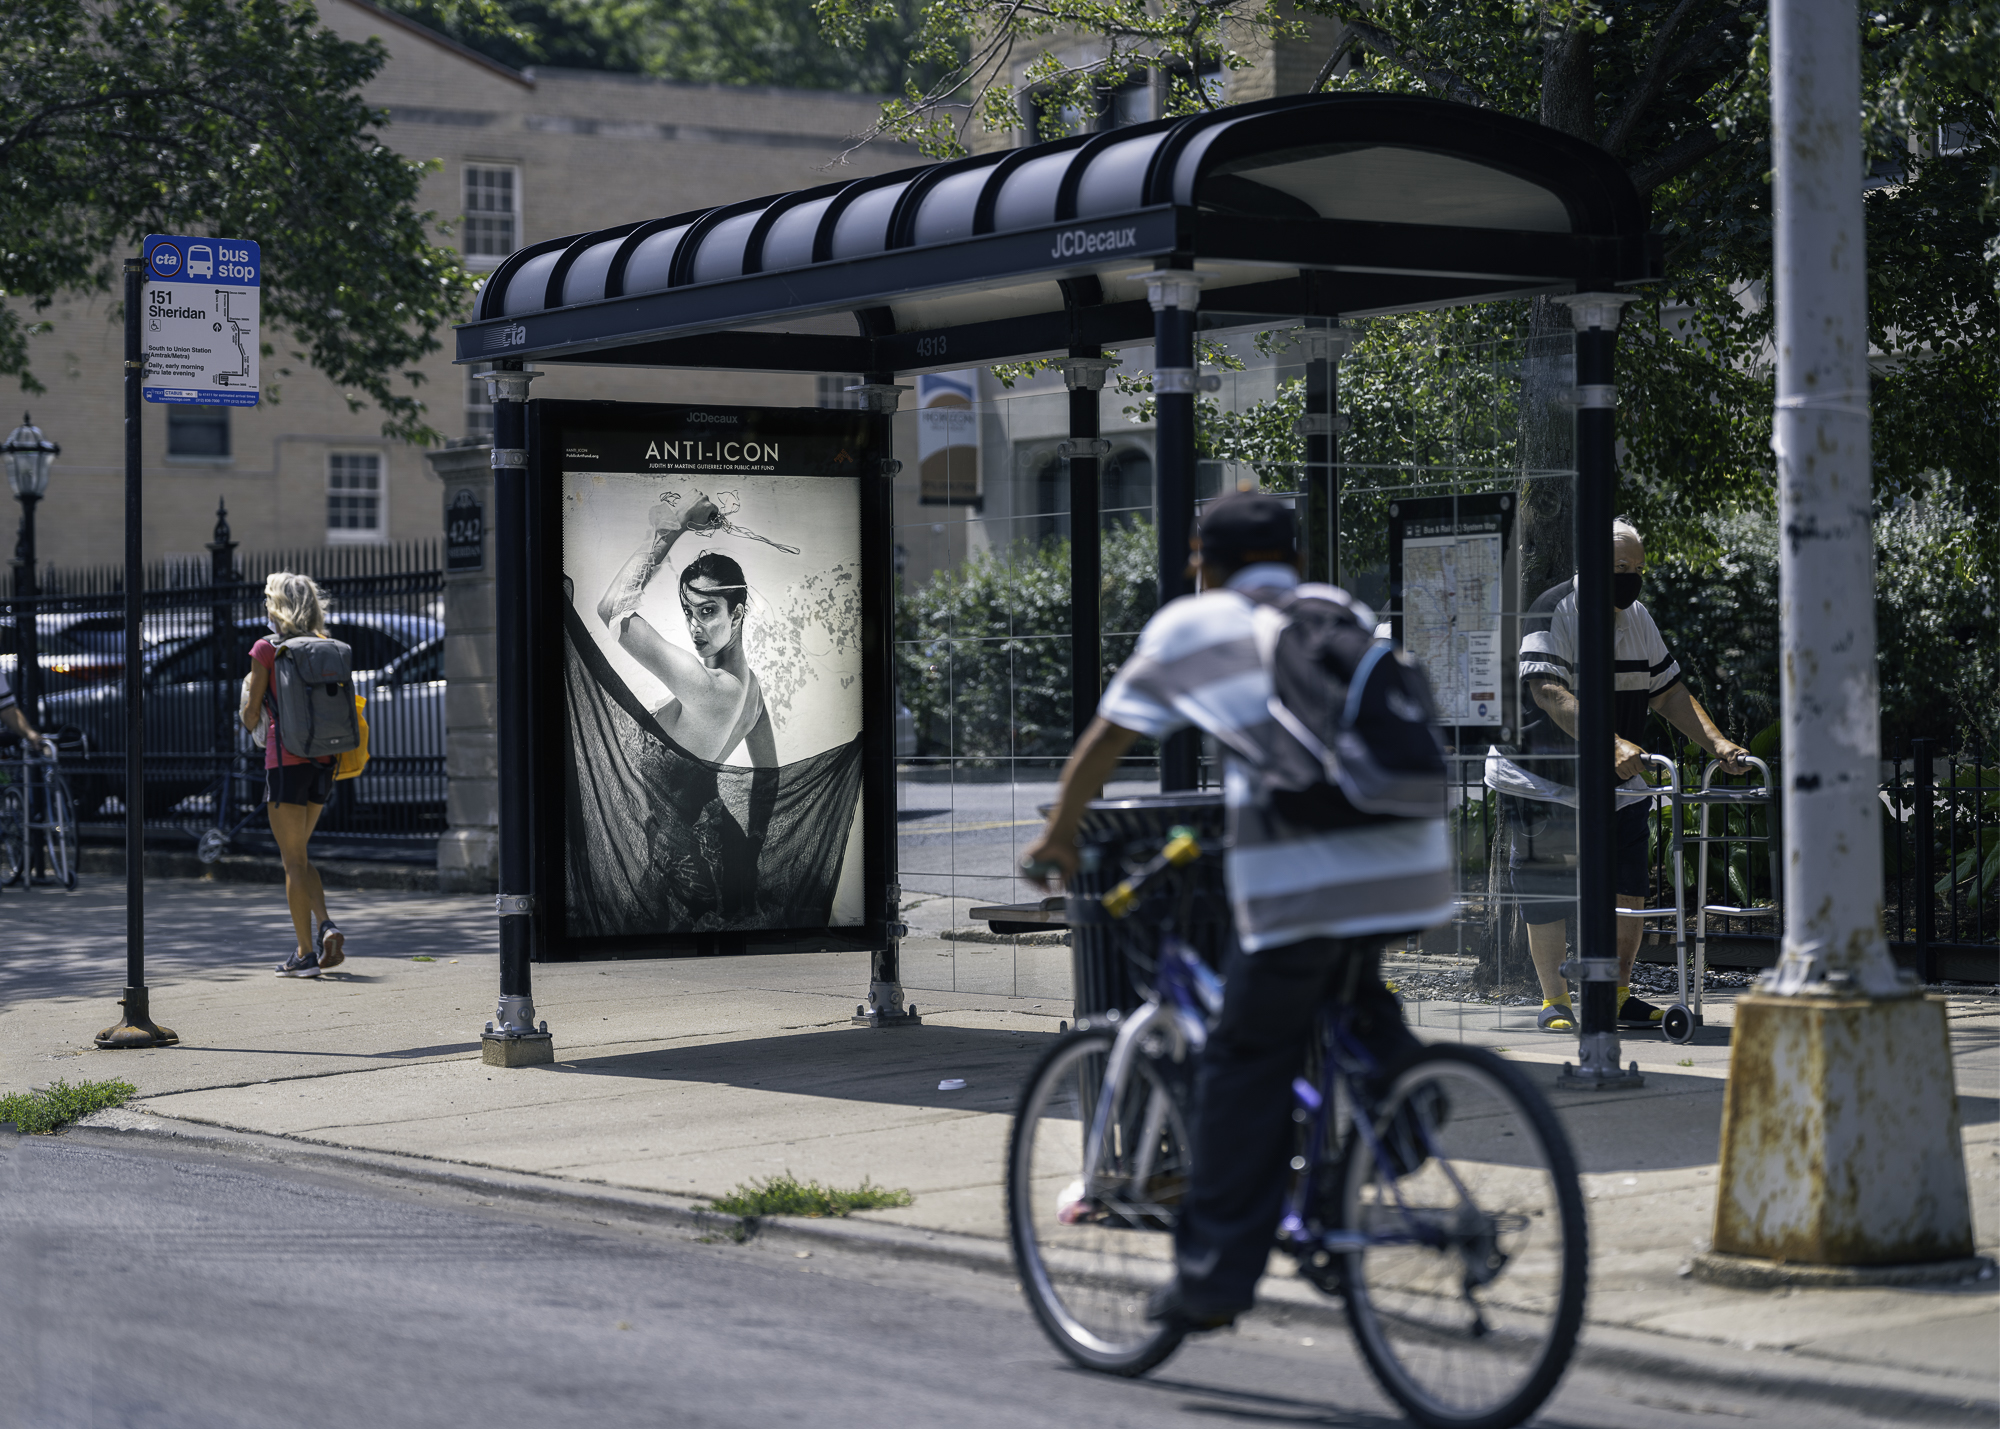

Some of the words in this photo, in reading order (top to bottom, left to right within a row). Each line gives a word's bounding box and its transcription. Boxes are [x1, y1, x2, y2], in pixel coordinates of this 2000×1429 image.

[1051, 227, 1136, 259] JCDecaux
[155, 254, 178, 265] cta
[218, 246, 249, 262] bus
[218, 263, 255, 282] stop
[149, 290, 172, 304] 151
[149, 305, 206, 320] Sheridan
[916, 335, 947, 357] 4313
[686, 412, 738, 424] JCDecaux
[644, 440, 779, 462] ANTI-ICON
[450, 518, 480, 544] 4242
[1463, 523, 1483, 533] System
[1484, 522, 1497, 532] Map
